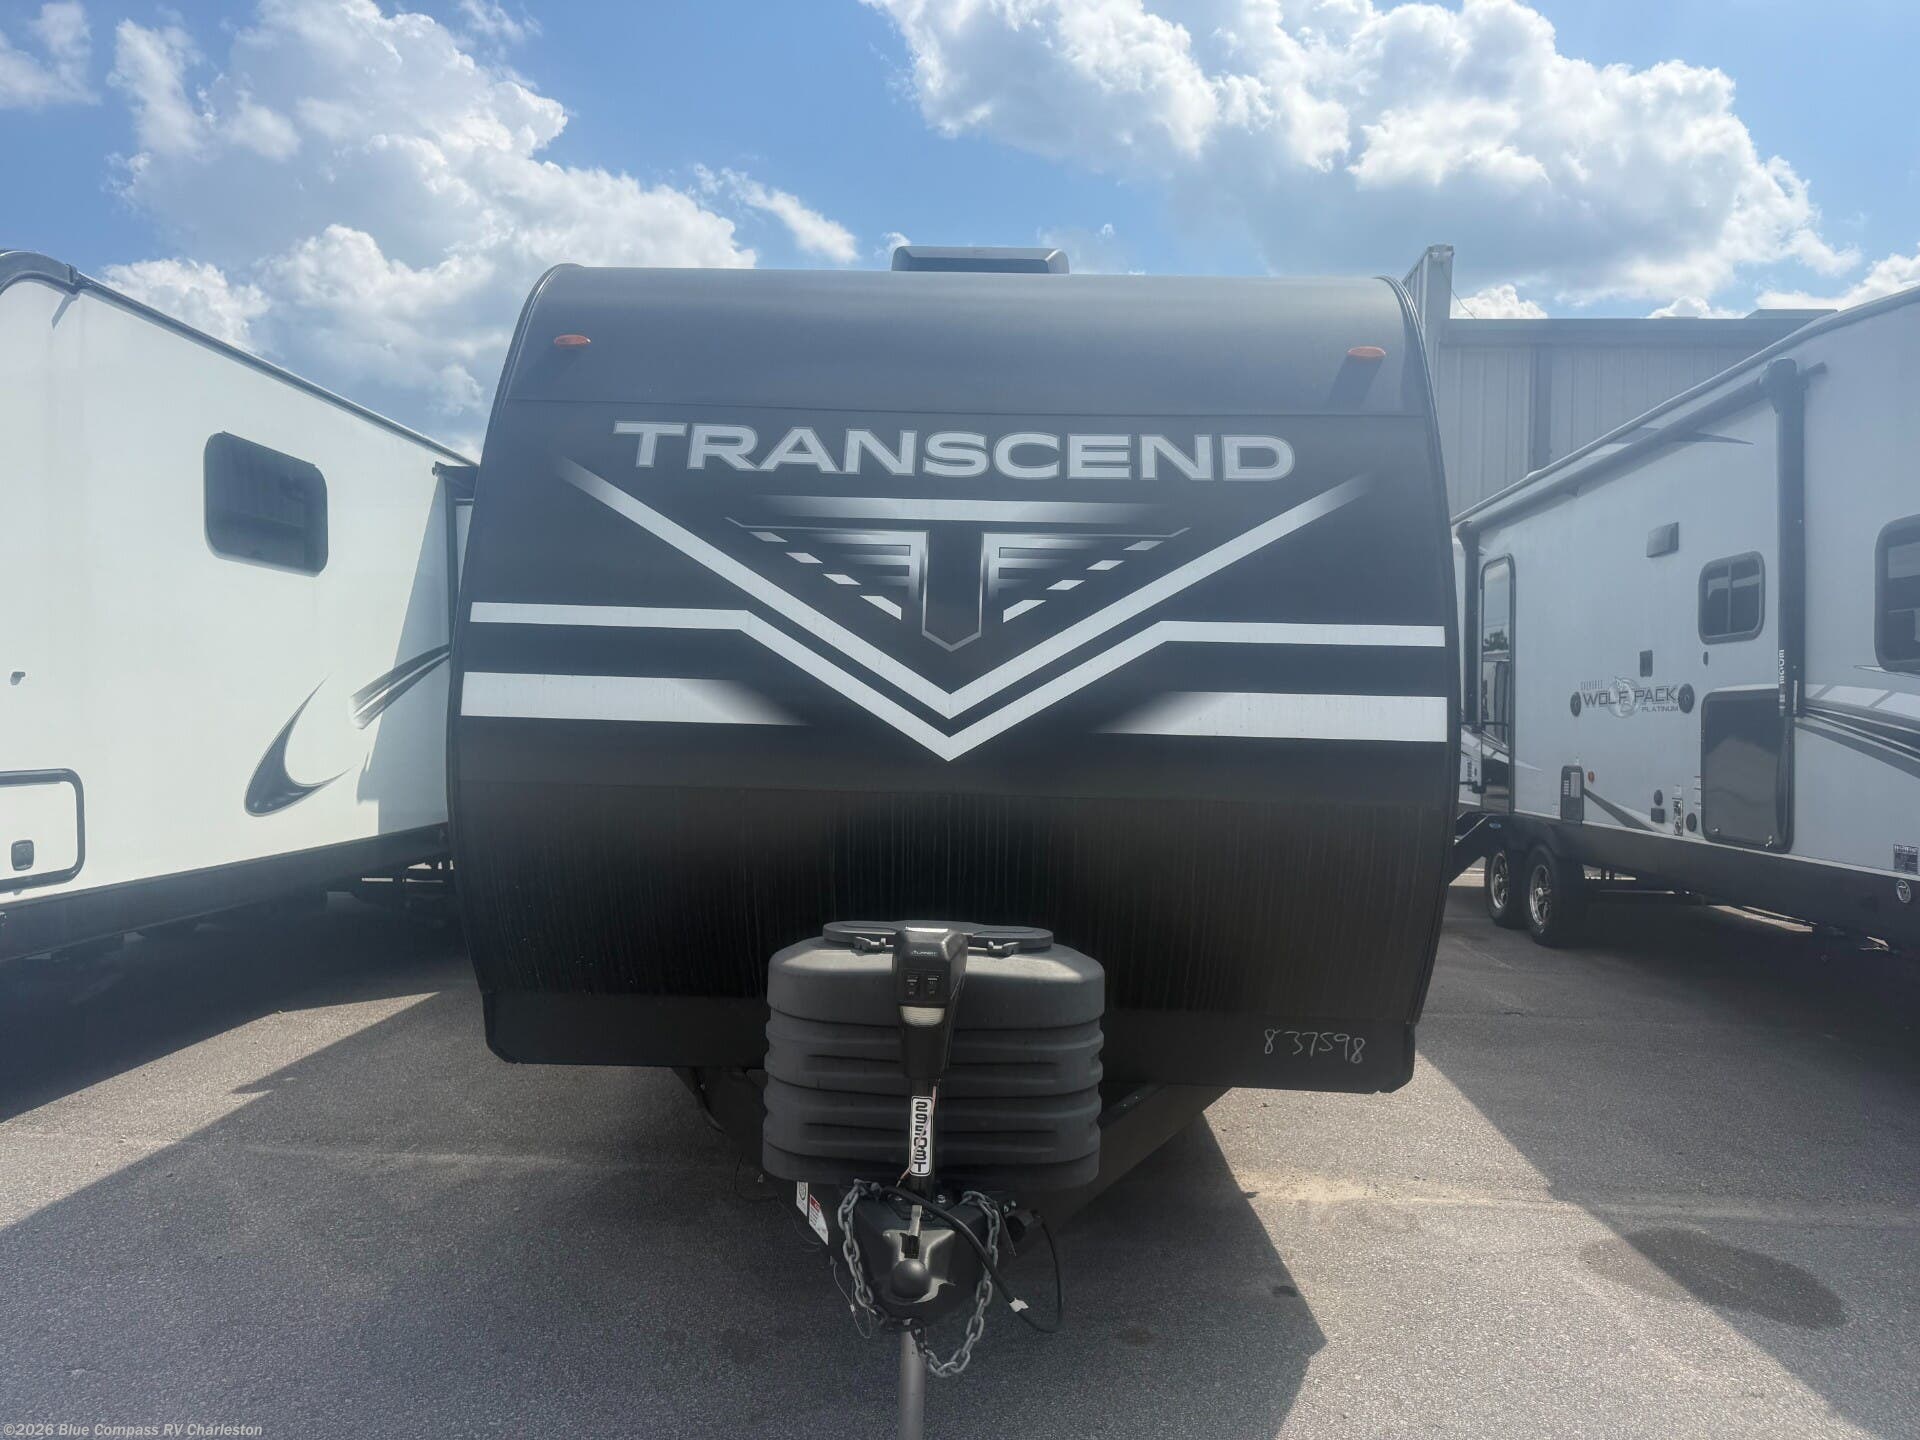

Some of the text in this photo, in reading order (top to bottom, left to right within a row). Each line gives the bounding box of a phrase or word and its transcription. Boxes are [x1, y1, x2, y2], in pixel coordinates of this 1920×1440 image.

[613, 420, 1295, 482] TRANSCEND
[1582, 686, 1677, 707] WOLF PACK
[1641, 705, 1680, 713] PLATINUM
